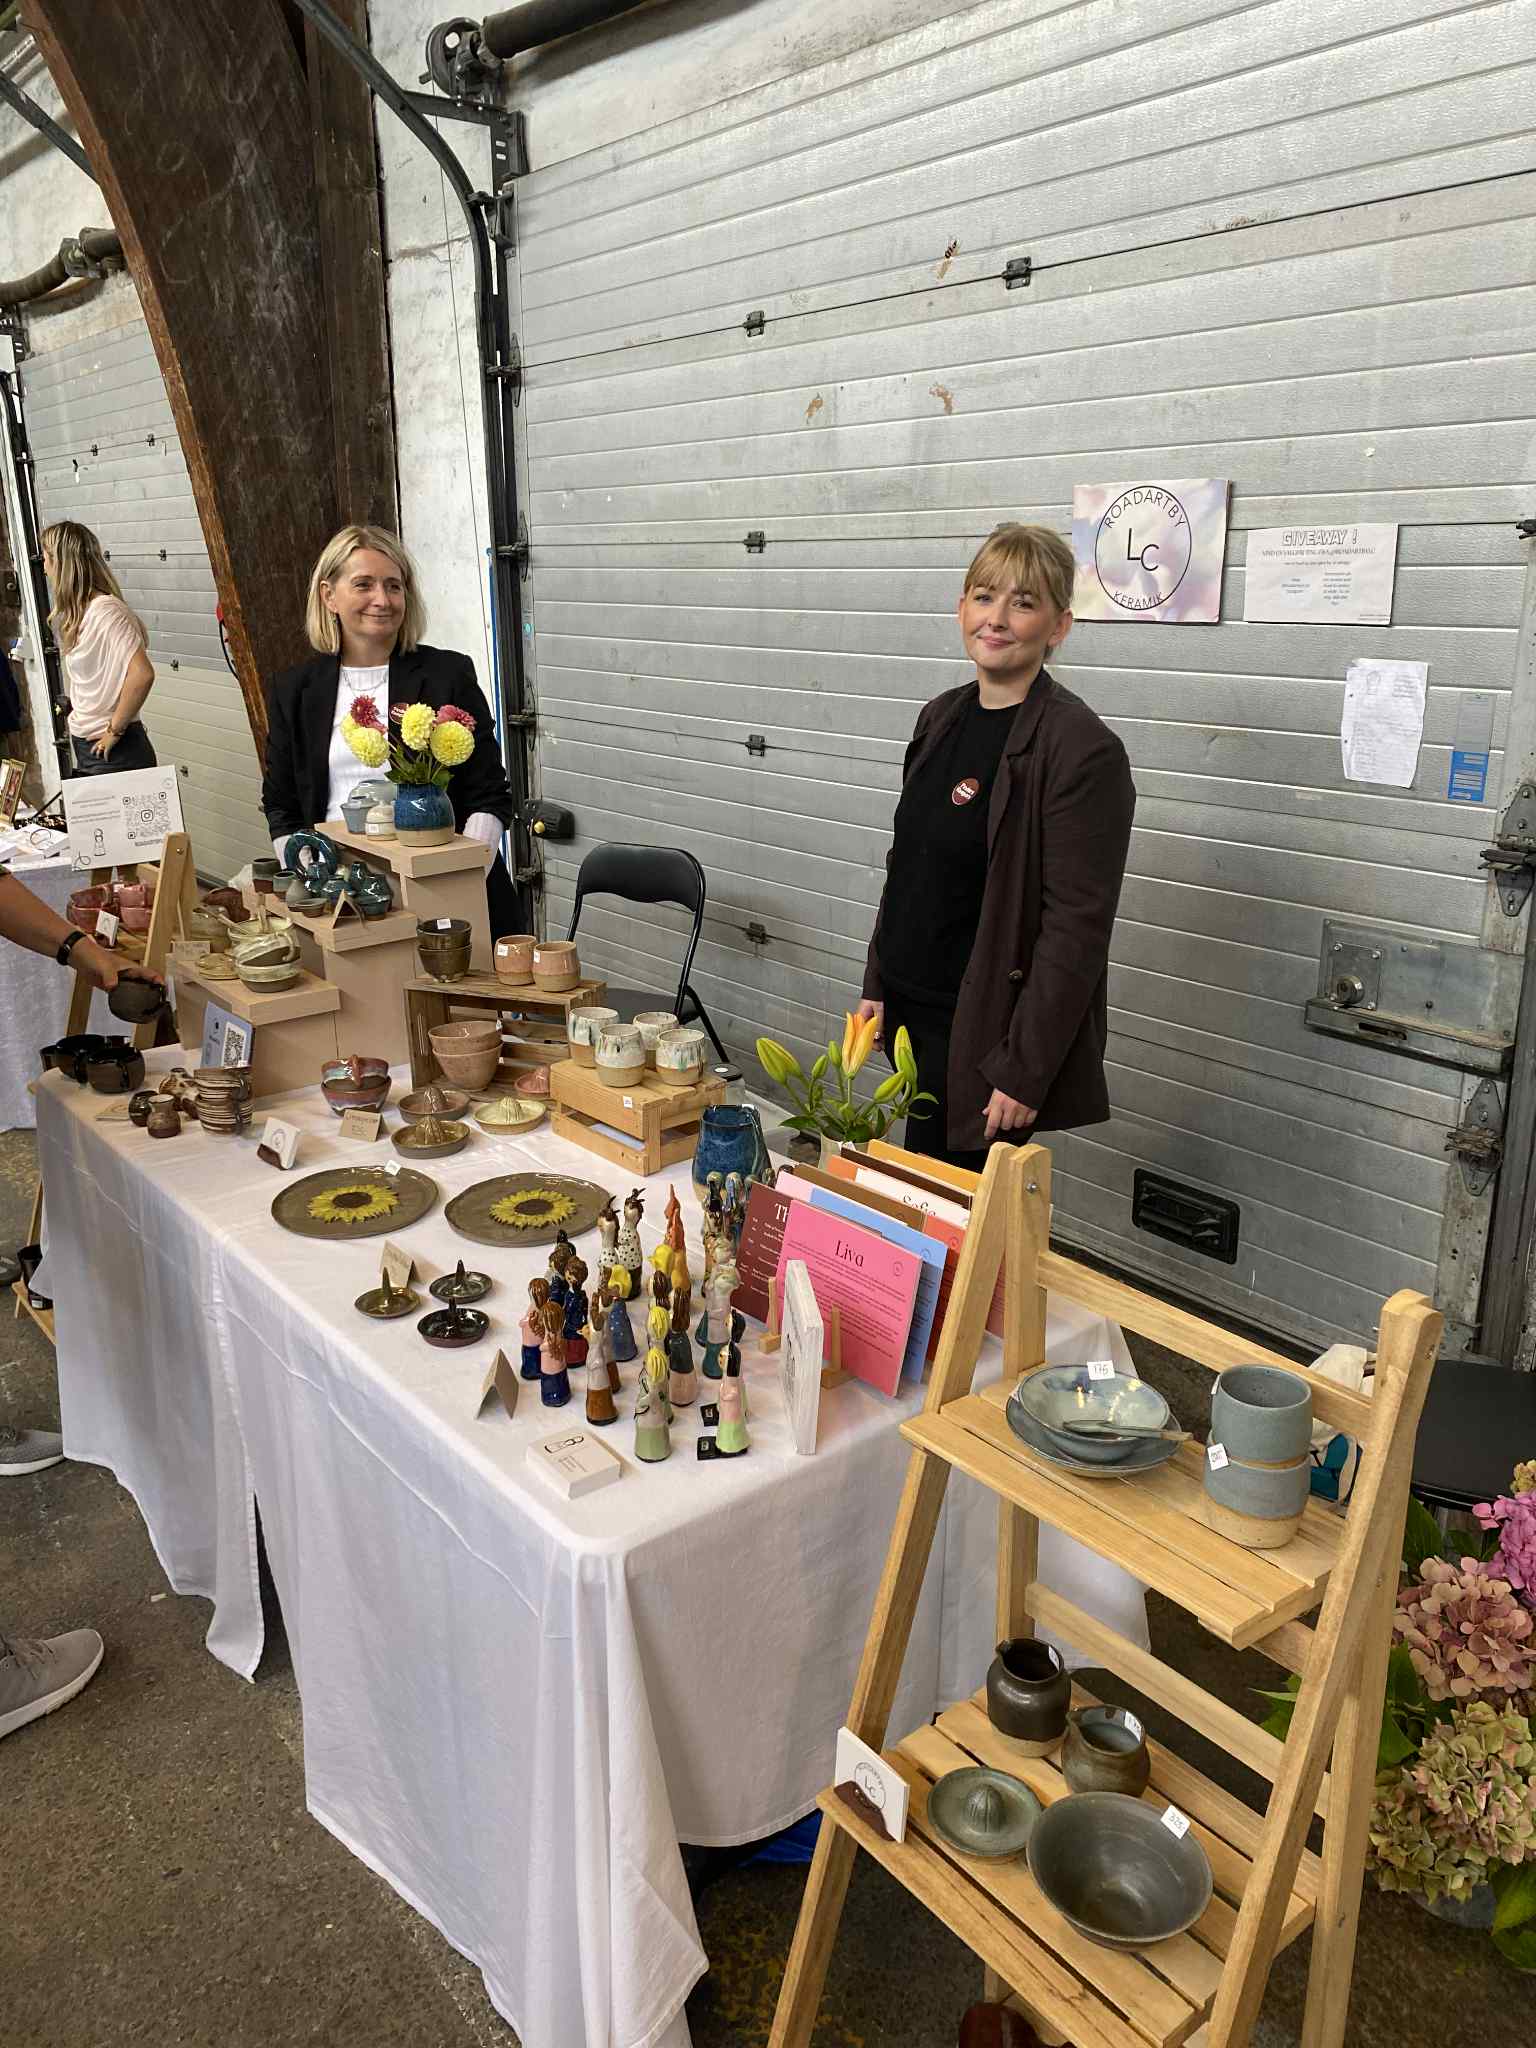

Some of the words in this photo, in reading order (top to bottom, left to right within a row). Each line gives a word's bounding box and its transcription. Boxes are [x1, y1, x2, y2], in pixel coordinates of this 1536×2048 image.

[1104, 489, 1186, 528] ROADARTBY
[1127, 528, 1159, 571] LC
[1281, 529, 1348, 546] GIVEAWAY
[1113, 591, 1164, 608] KERAMIK
[834, 1240, 864, 1267] Liva
